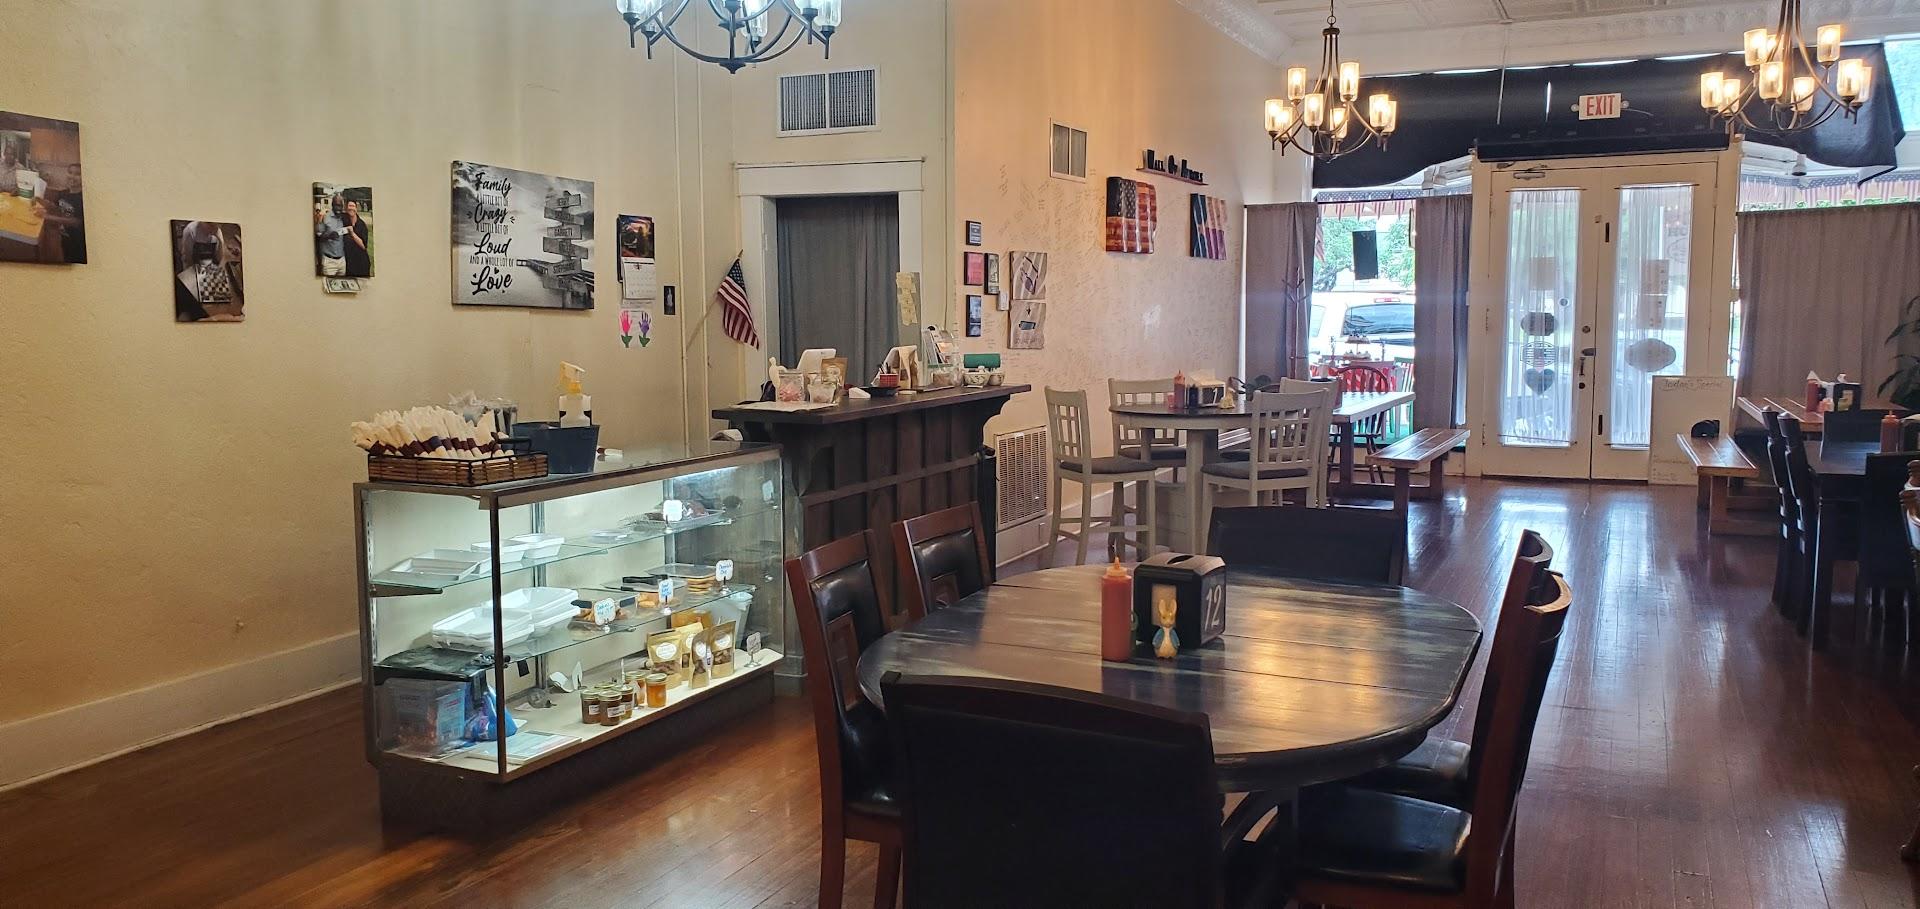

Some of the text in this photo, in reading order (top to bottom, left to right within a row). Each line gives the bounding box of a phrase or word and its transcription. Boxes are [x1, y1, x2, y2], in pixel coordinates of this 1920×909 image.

[1586, 95, 1615, 116] EXIT
[475, 172, 512, 198] Family
[474, 202, 509, 224] Crazy
[480, 223, 494, 234] LITTLE
[473, 233, 512, 257] Loud
[470, 255, 479, 265] AND
[485, 256, 499, 267] WHOLE
[470, 265, 513, 296] Love
[1204, 585, 1222, 632] 12
